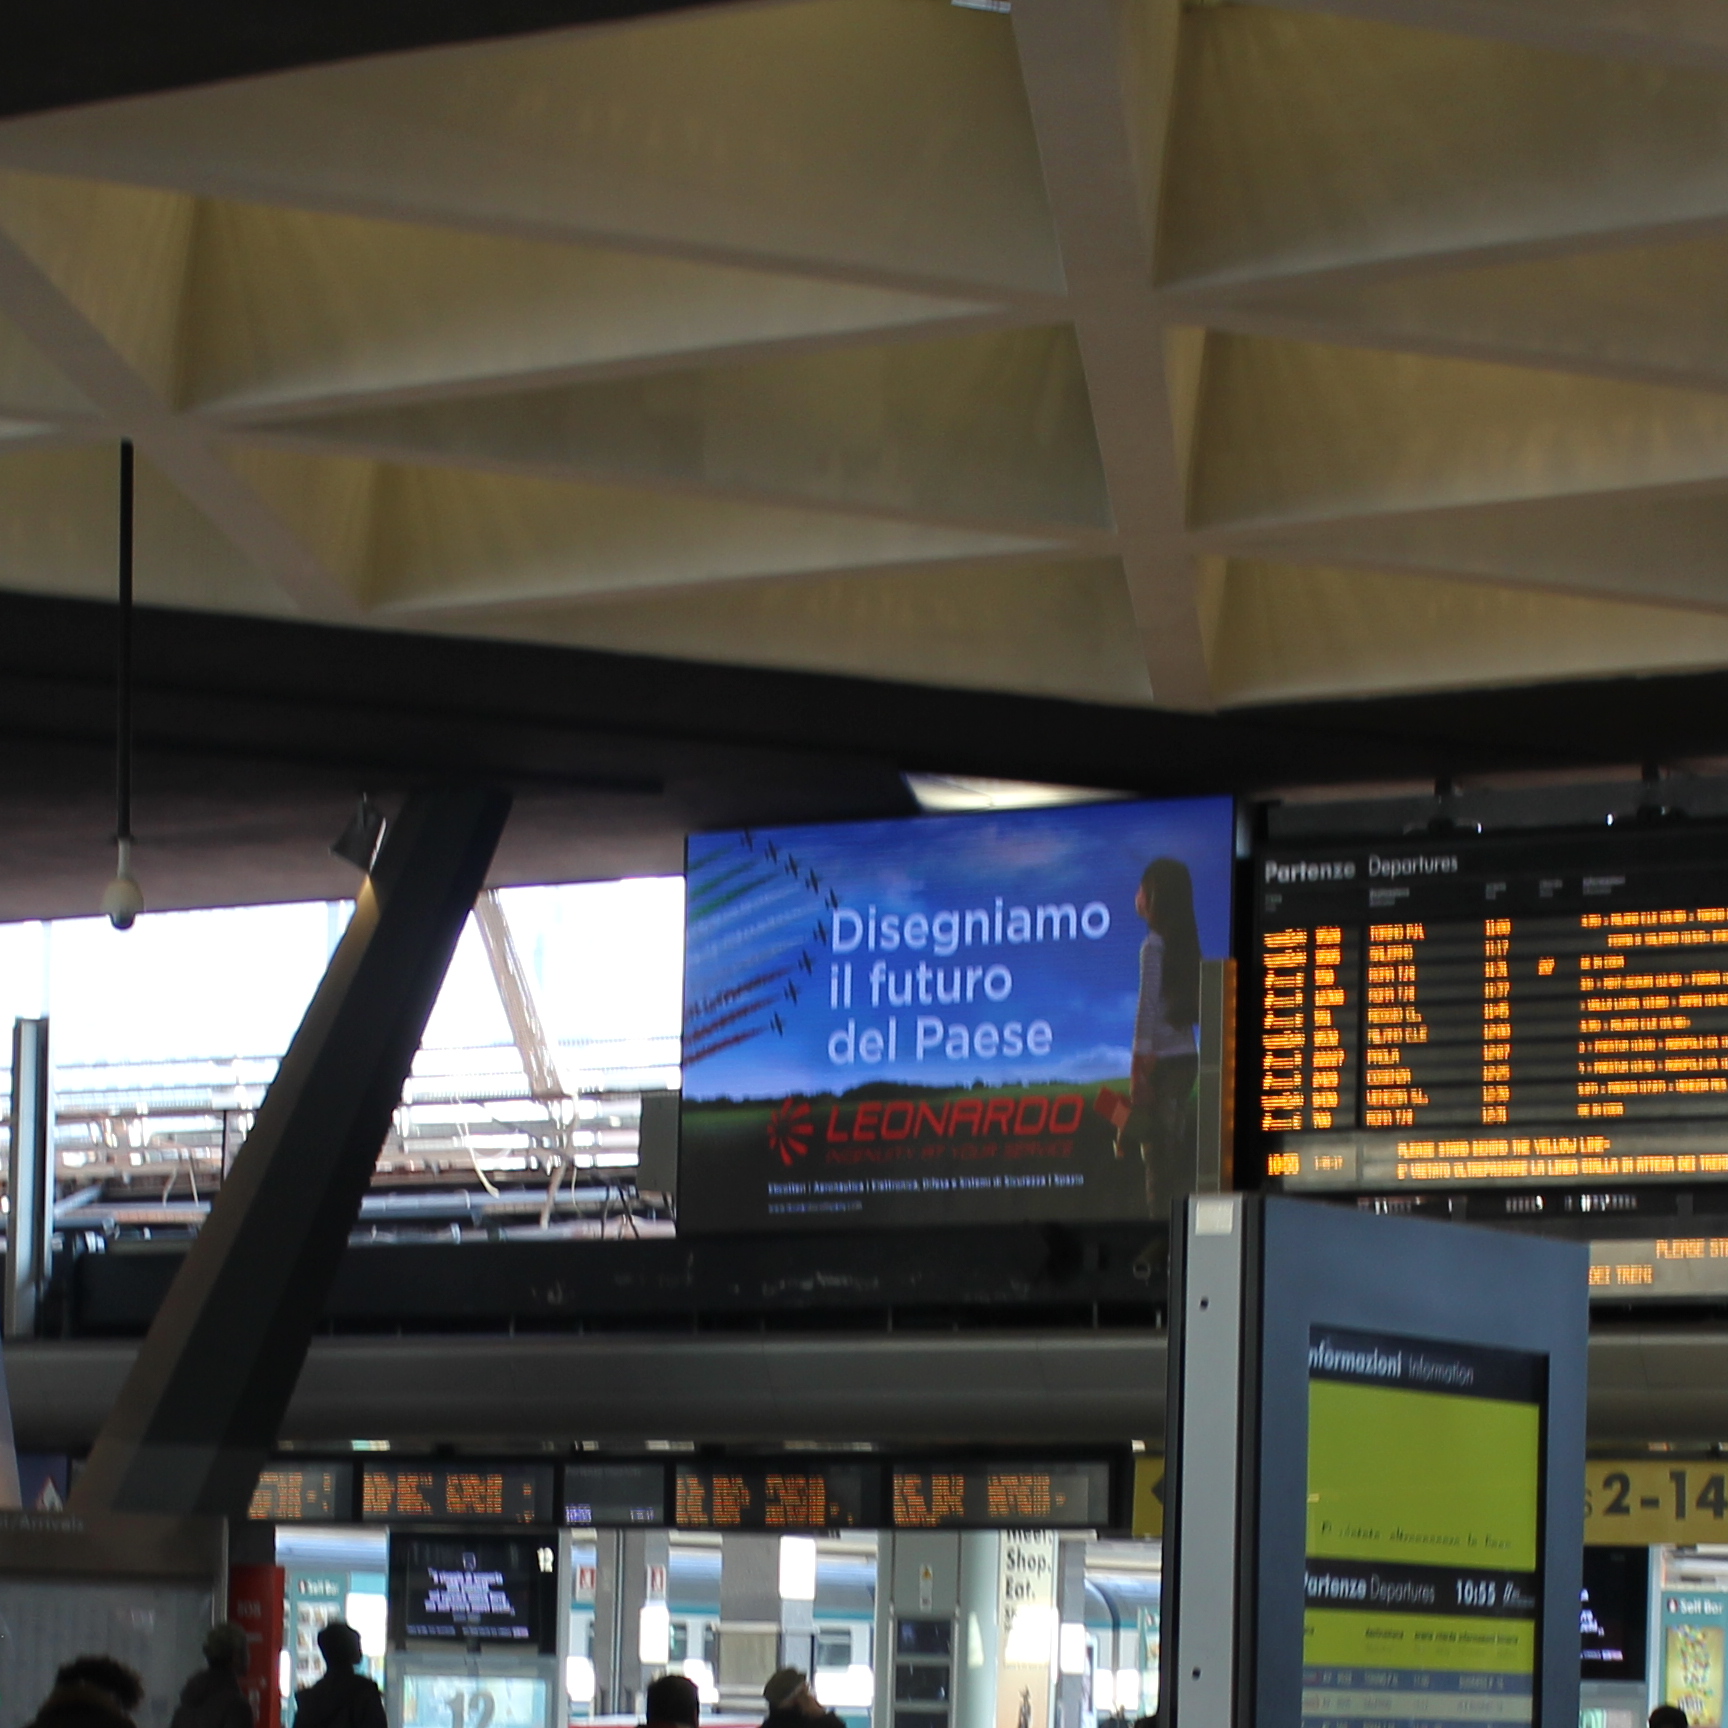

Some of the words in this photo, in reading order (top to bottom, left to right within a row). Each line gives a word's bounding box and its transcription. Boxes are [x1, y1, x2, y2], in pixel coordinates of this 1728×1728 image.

[1265, 859, 1355, 884] Partenze
[1369, 854, 1458, 881] Departures
[831, 896, 1111, 956] Disegniamo
[829, 963, 853, 1009] il
[869, 960, 1013, 1008] futuro
[827, 1017, 898, 1065] del
[915, 1015, 1054, 1062] Paese
[826, 1092, 1085, 1143] LEONARDO
[1656, 1238, 1705, 1259] PLEASE
[1615, 1264, 1653, 1285] TRENI
[1408, 1352, 1474, 1389] Information
[1603, 1470, 1728, 1521] 2-14
[1006, 1551, 1053, 1575] Shop.
[1005, 1578, 1036, 1600] Eat.
[1370, 1573, 1436, 1606] Departures
[1456, 1579, 1496, 1608] 10:55
